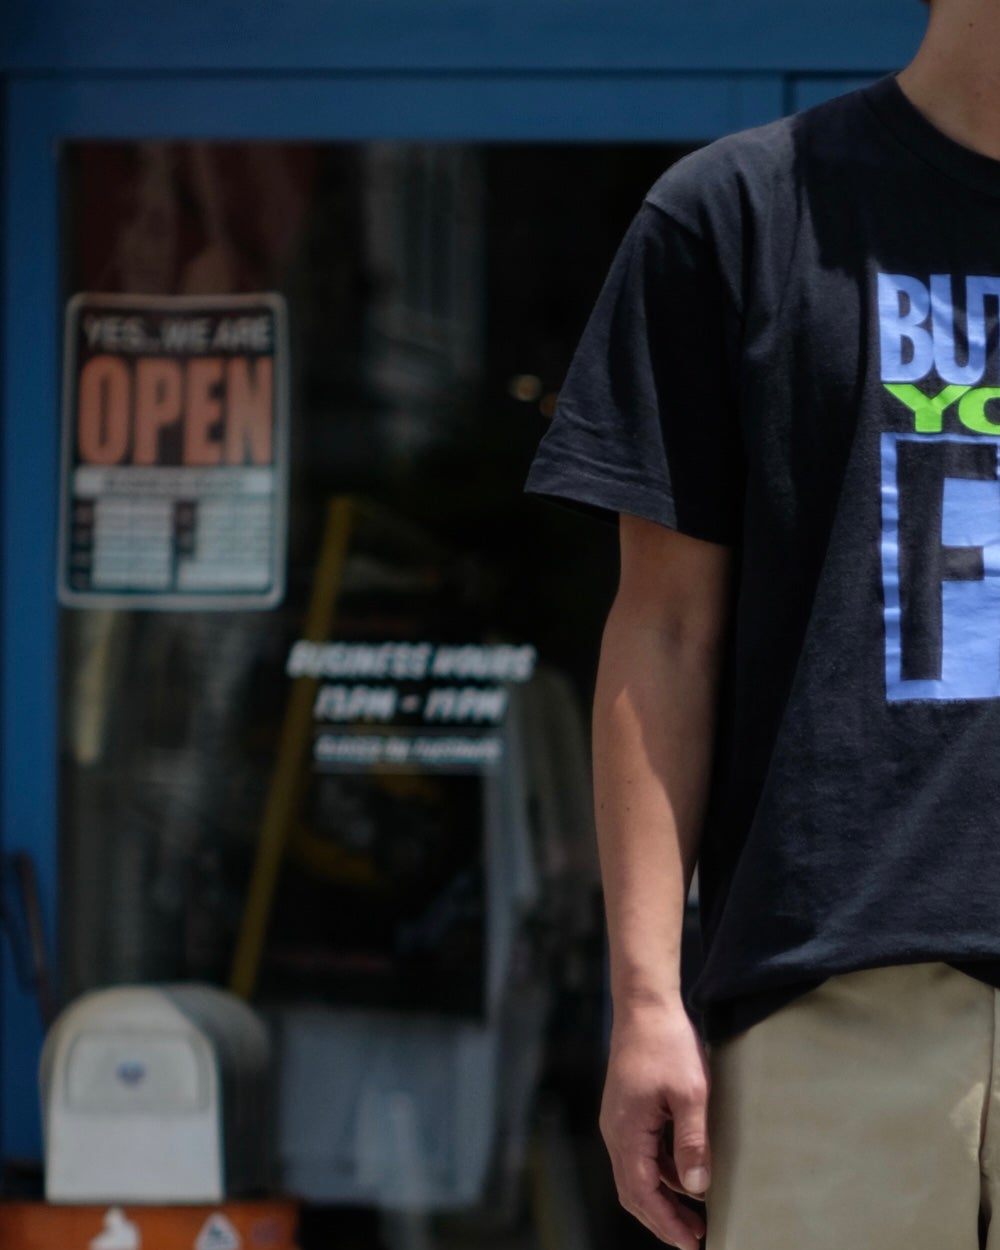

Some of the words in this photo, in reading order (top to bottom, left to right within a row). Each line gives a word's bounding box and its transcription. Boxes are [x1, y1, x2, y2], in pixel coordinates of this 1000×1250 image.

[214, 316, 271, 349] ARE
[79, 355, 273, 465] OPEN
[288, 641, 430, 676] BUSINESS
[433, 645, 535, 681] HOURS
